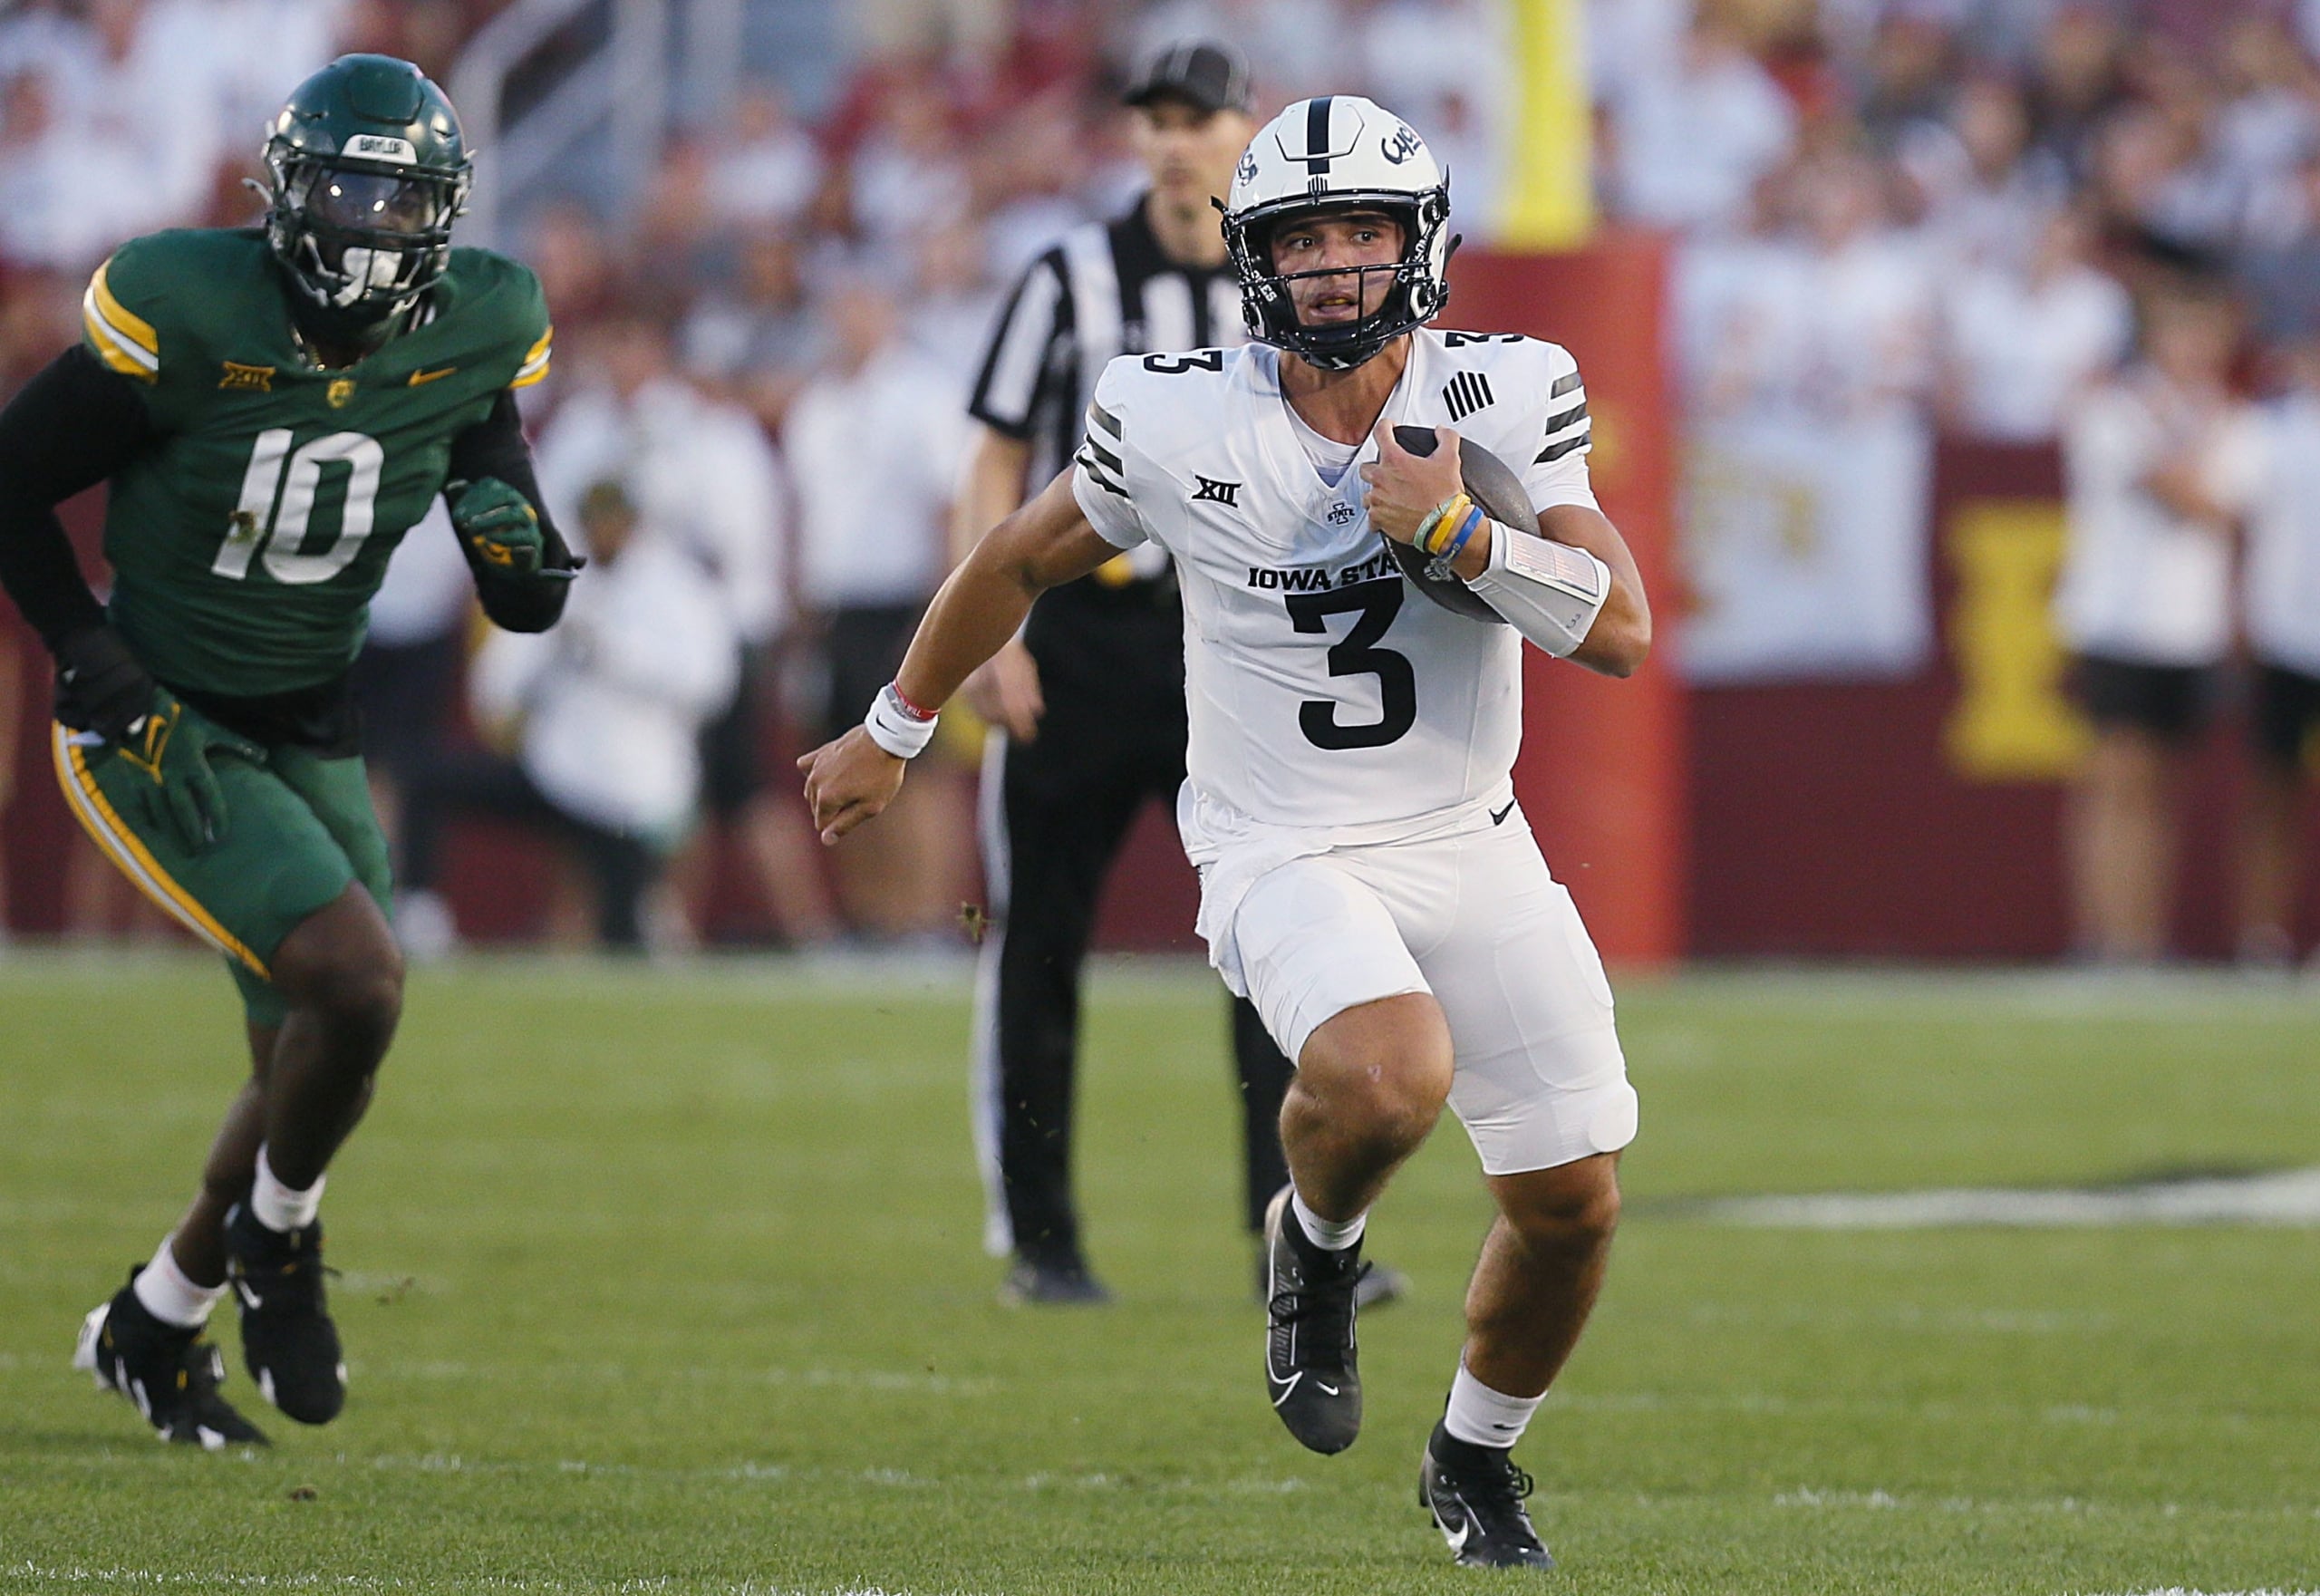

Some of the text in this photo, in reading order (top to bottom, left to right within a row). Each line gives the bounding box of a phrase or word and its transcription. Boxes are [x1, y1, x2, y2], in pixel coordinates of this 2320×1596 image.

[1143, 350, 1223, 375] 3
[210, 428, 385, 585] 10
[1191, 474, 1242, 509] XII
[1247, 552, 1401, 591] IOWA STA
[1283, 577, 1418, 751] 3
